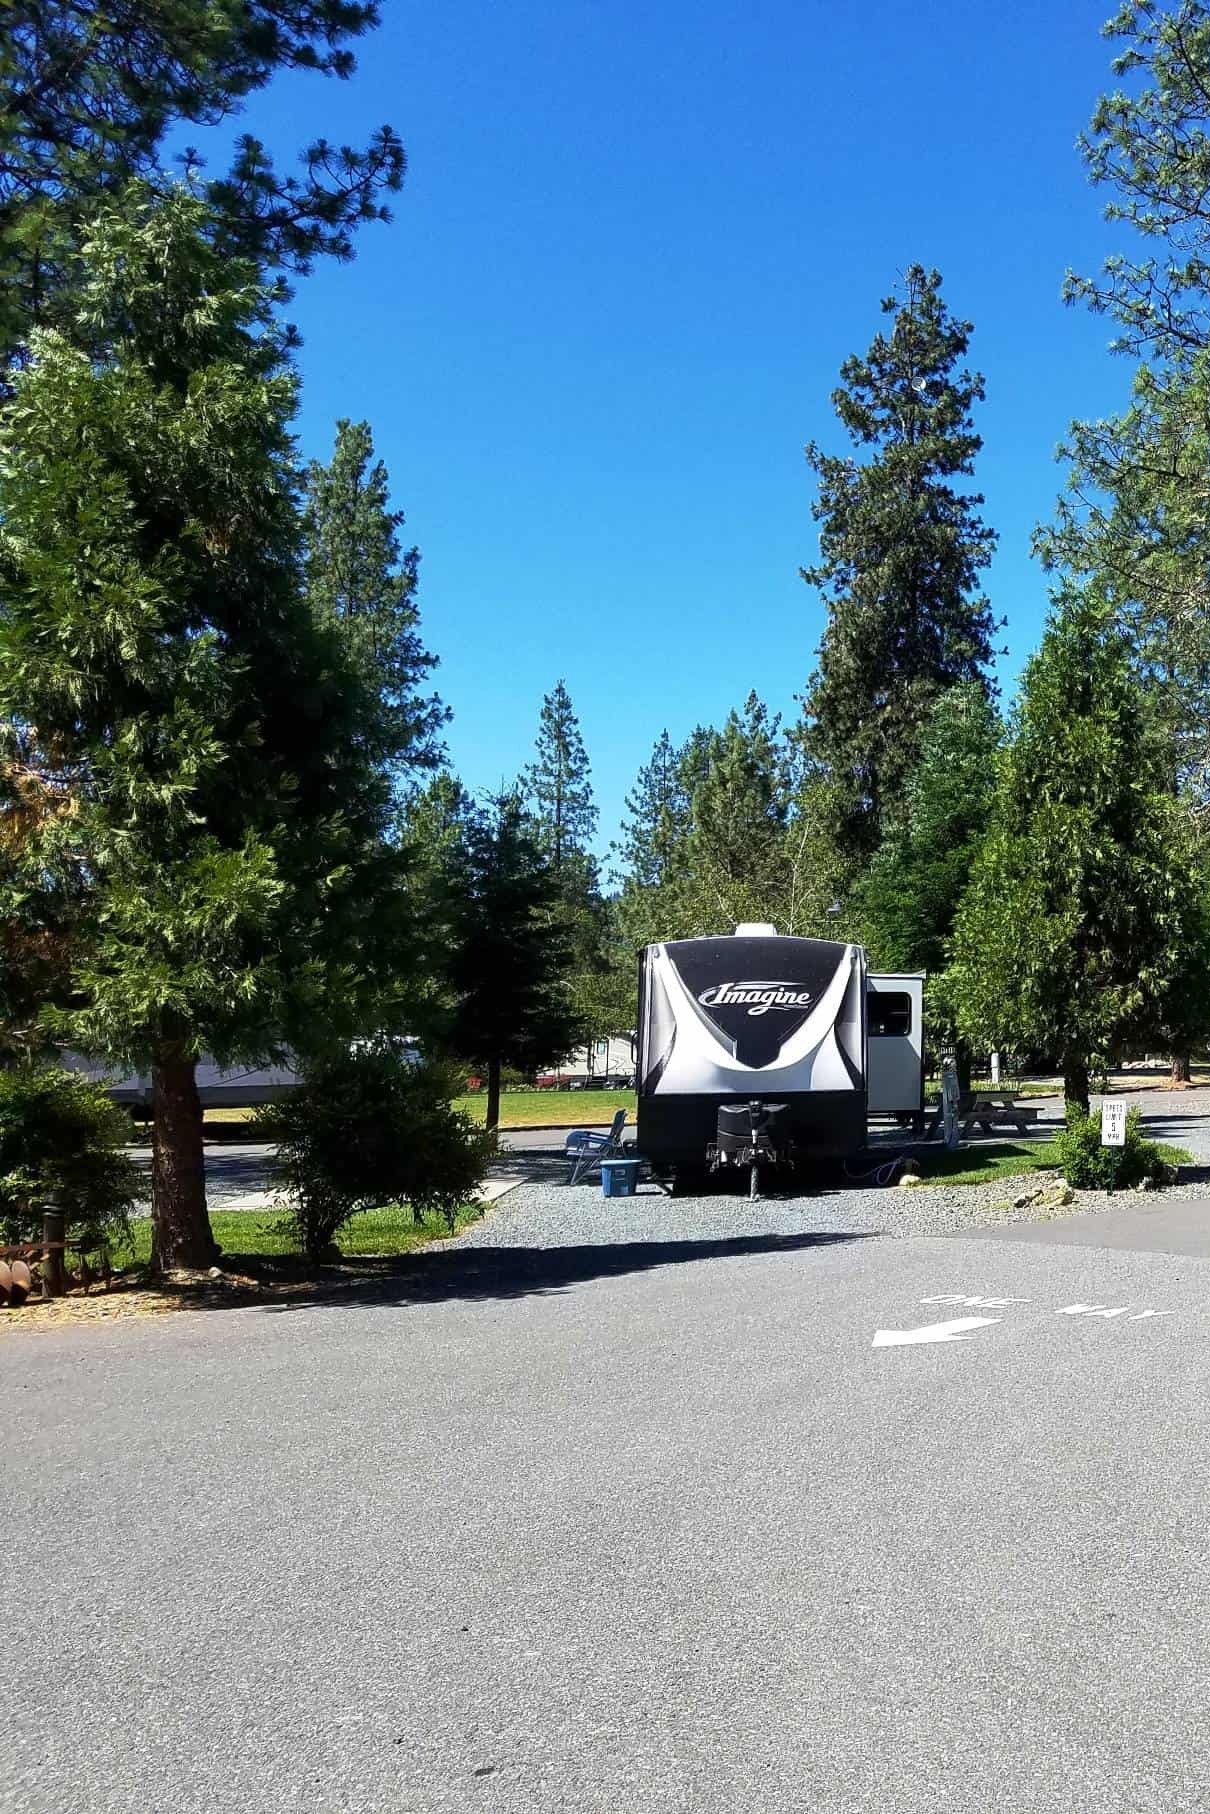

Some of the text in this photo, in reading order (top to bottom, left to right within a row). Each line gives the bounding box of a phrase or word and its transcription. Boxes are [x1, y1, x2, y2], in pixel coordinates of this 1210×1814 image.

[708, 982, 813, 1015] Imagine
[1111, 1122, 1116, 1132] 5
[919, 1294, 1175, 1320] ONE WAY
